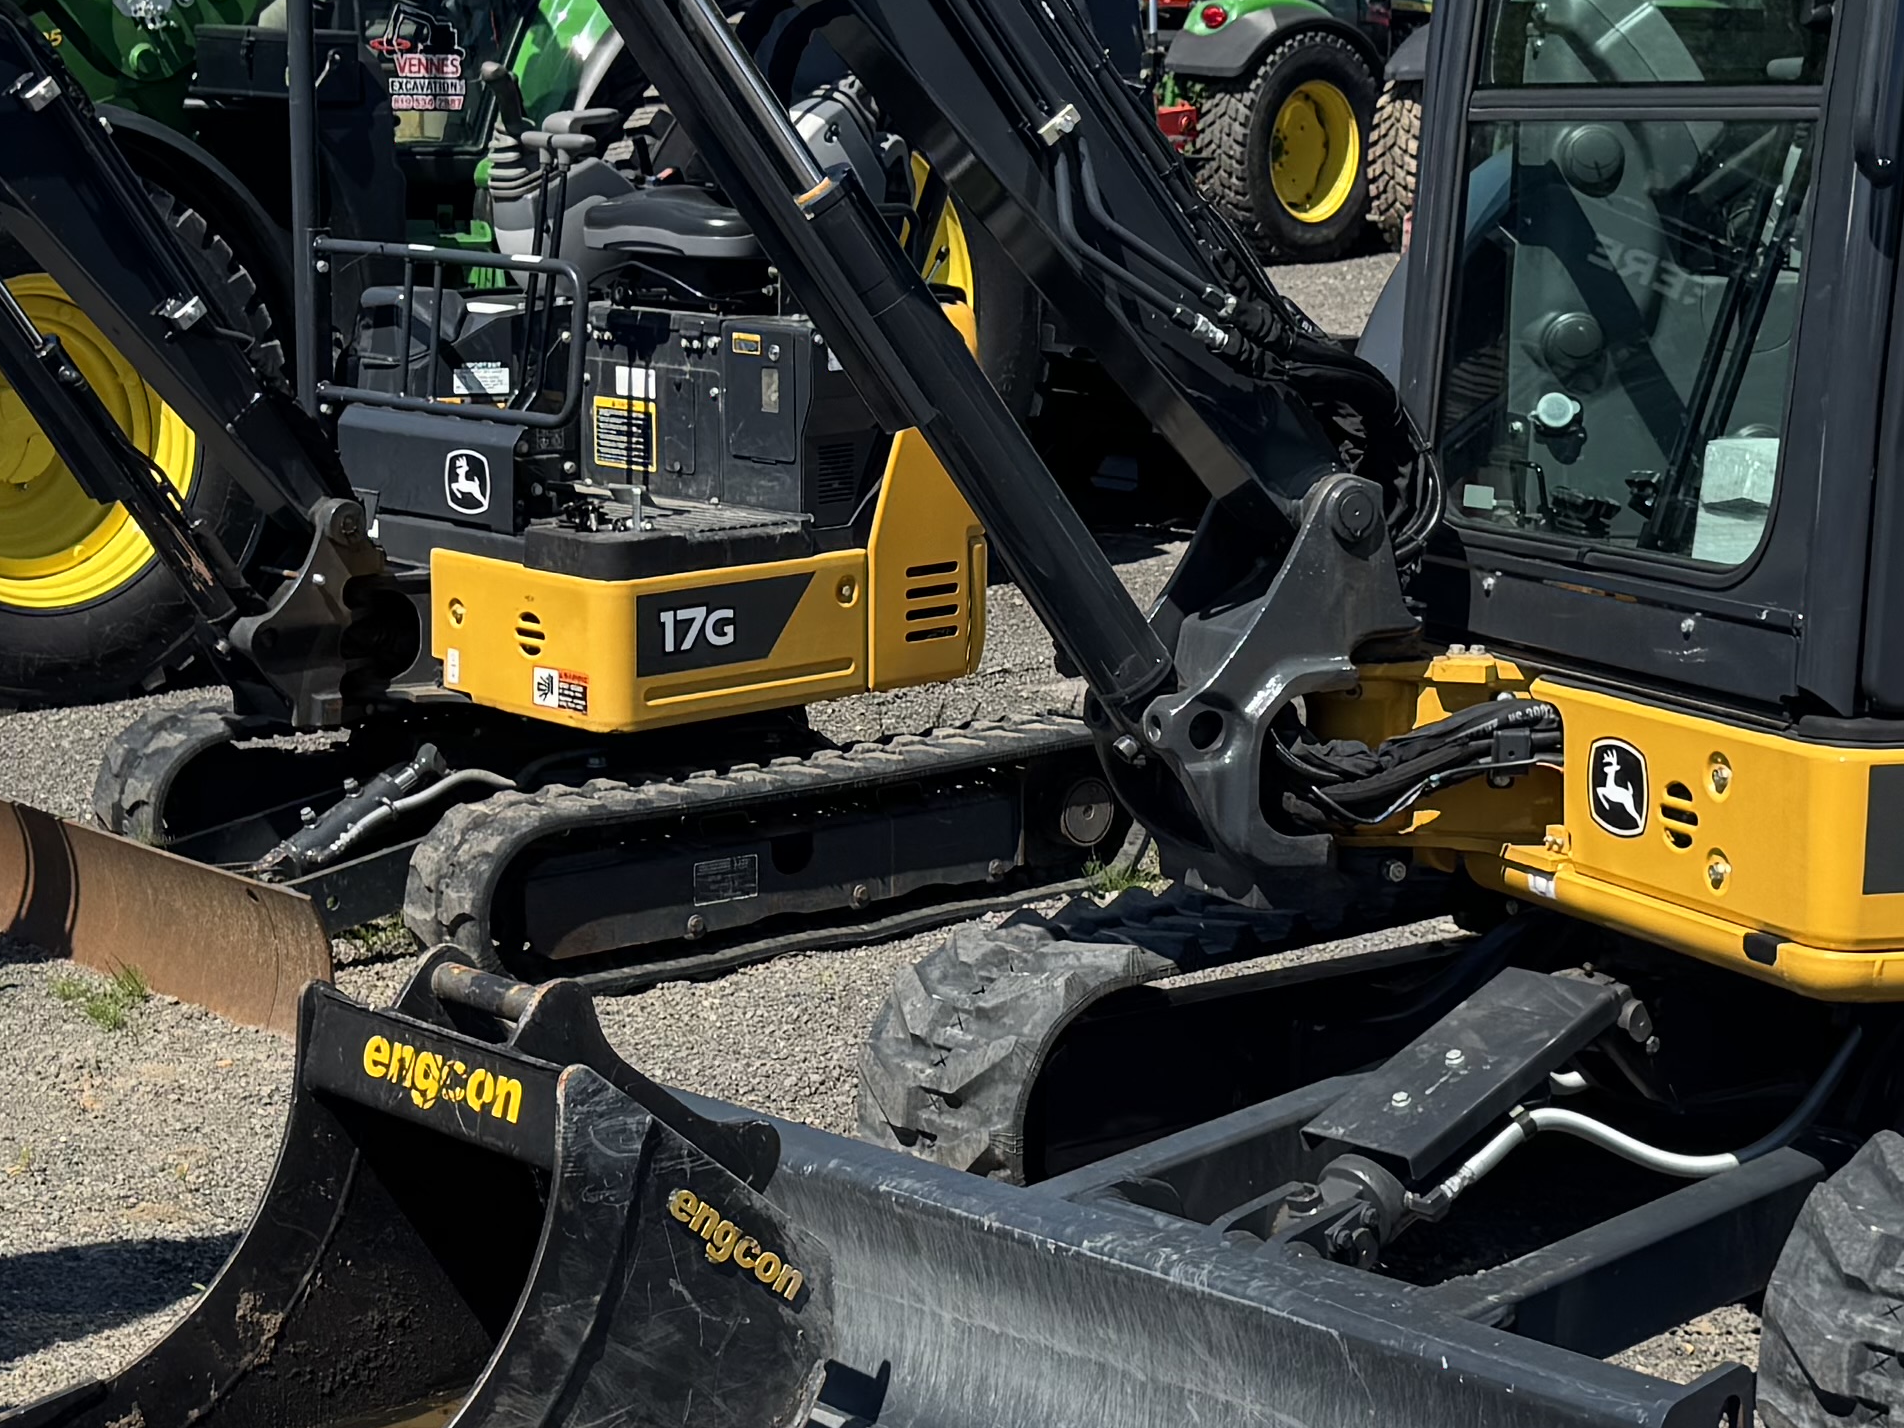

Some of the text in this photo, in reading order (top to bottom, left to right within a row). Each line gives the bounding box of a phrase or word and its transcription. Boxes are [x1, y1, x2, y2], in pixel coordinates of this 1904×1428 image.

[397, 56, 461, 75] VENNES
[660, 605, 734, 652] 17G
[363, 1035, 522, 1124] engcon
[668, 1188, 804, 1301] engcon
